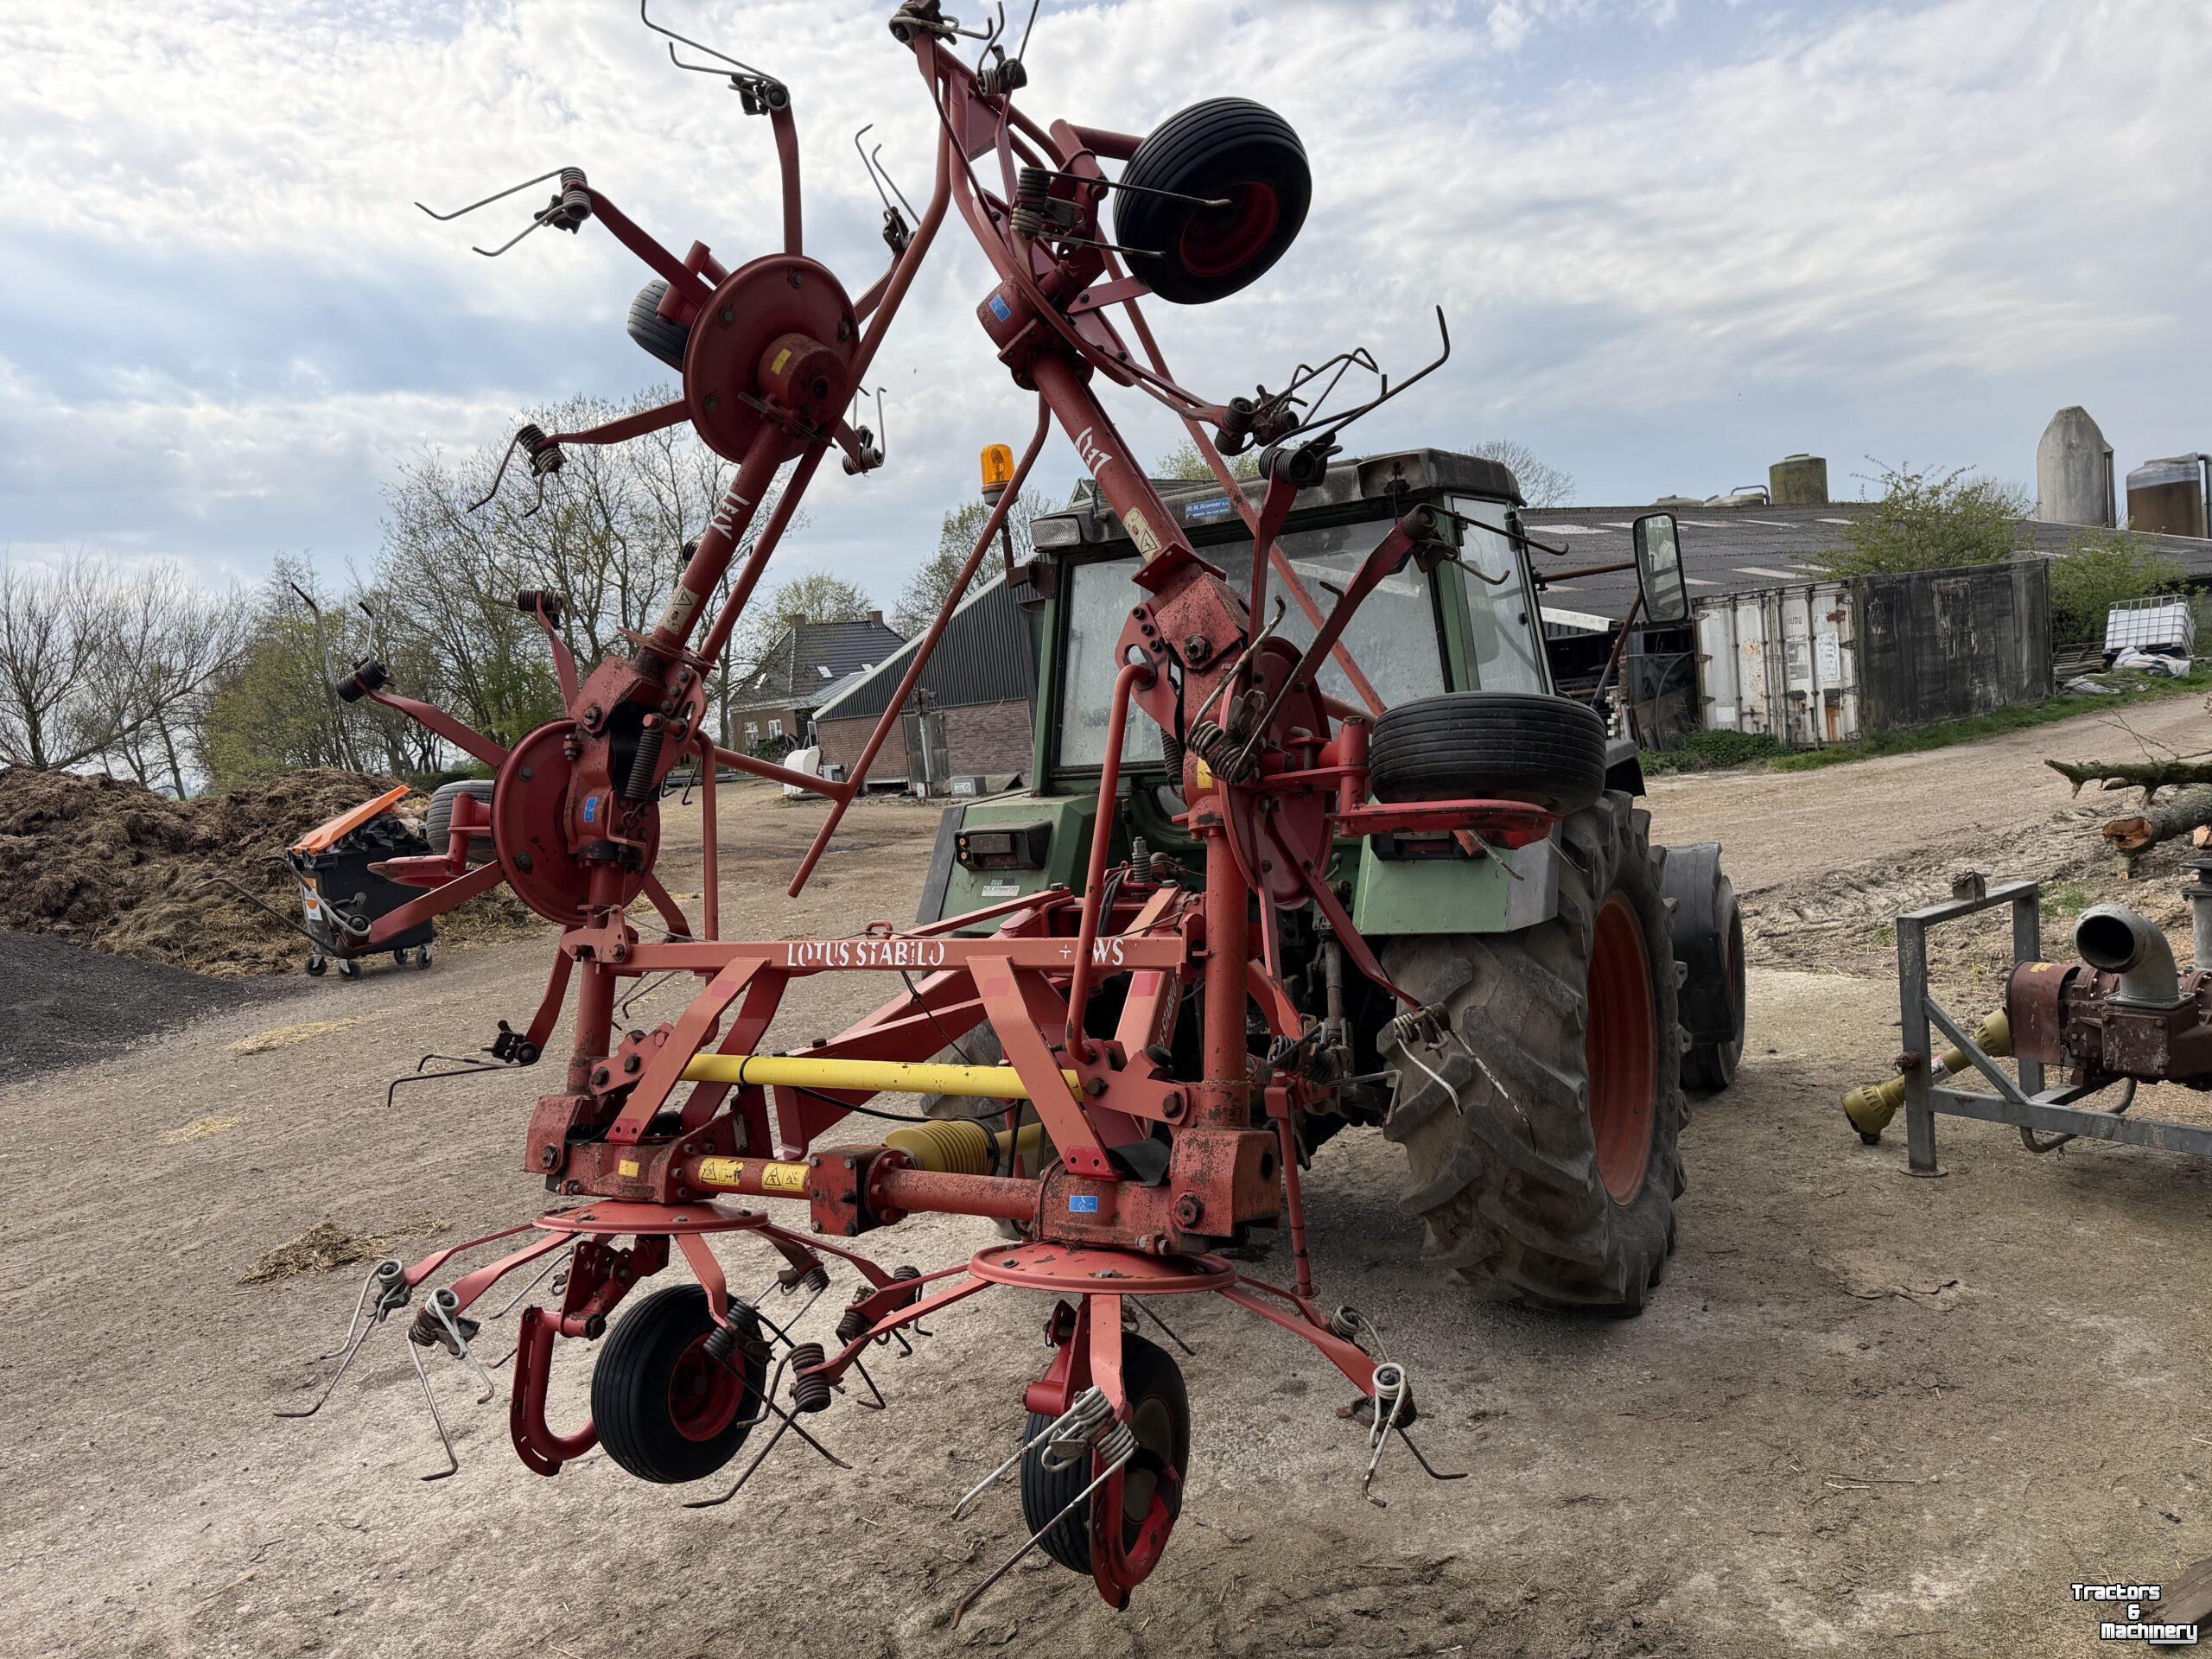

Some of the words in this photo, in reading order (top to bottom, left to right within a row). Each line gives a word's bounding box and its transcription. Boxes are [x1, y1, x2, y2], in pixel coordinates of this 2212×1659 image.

[787, 942, 849, 967] LOTUS
[855, 941, 945, 967] STABILO
[1091, 938, 1124, 966] WS
